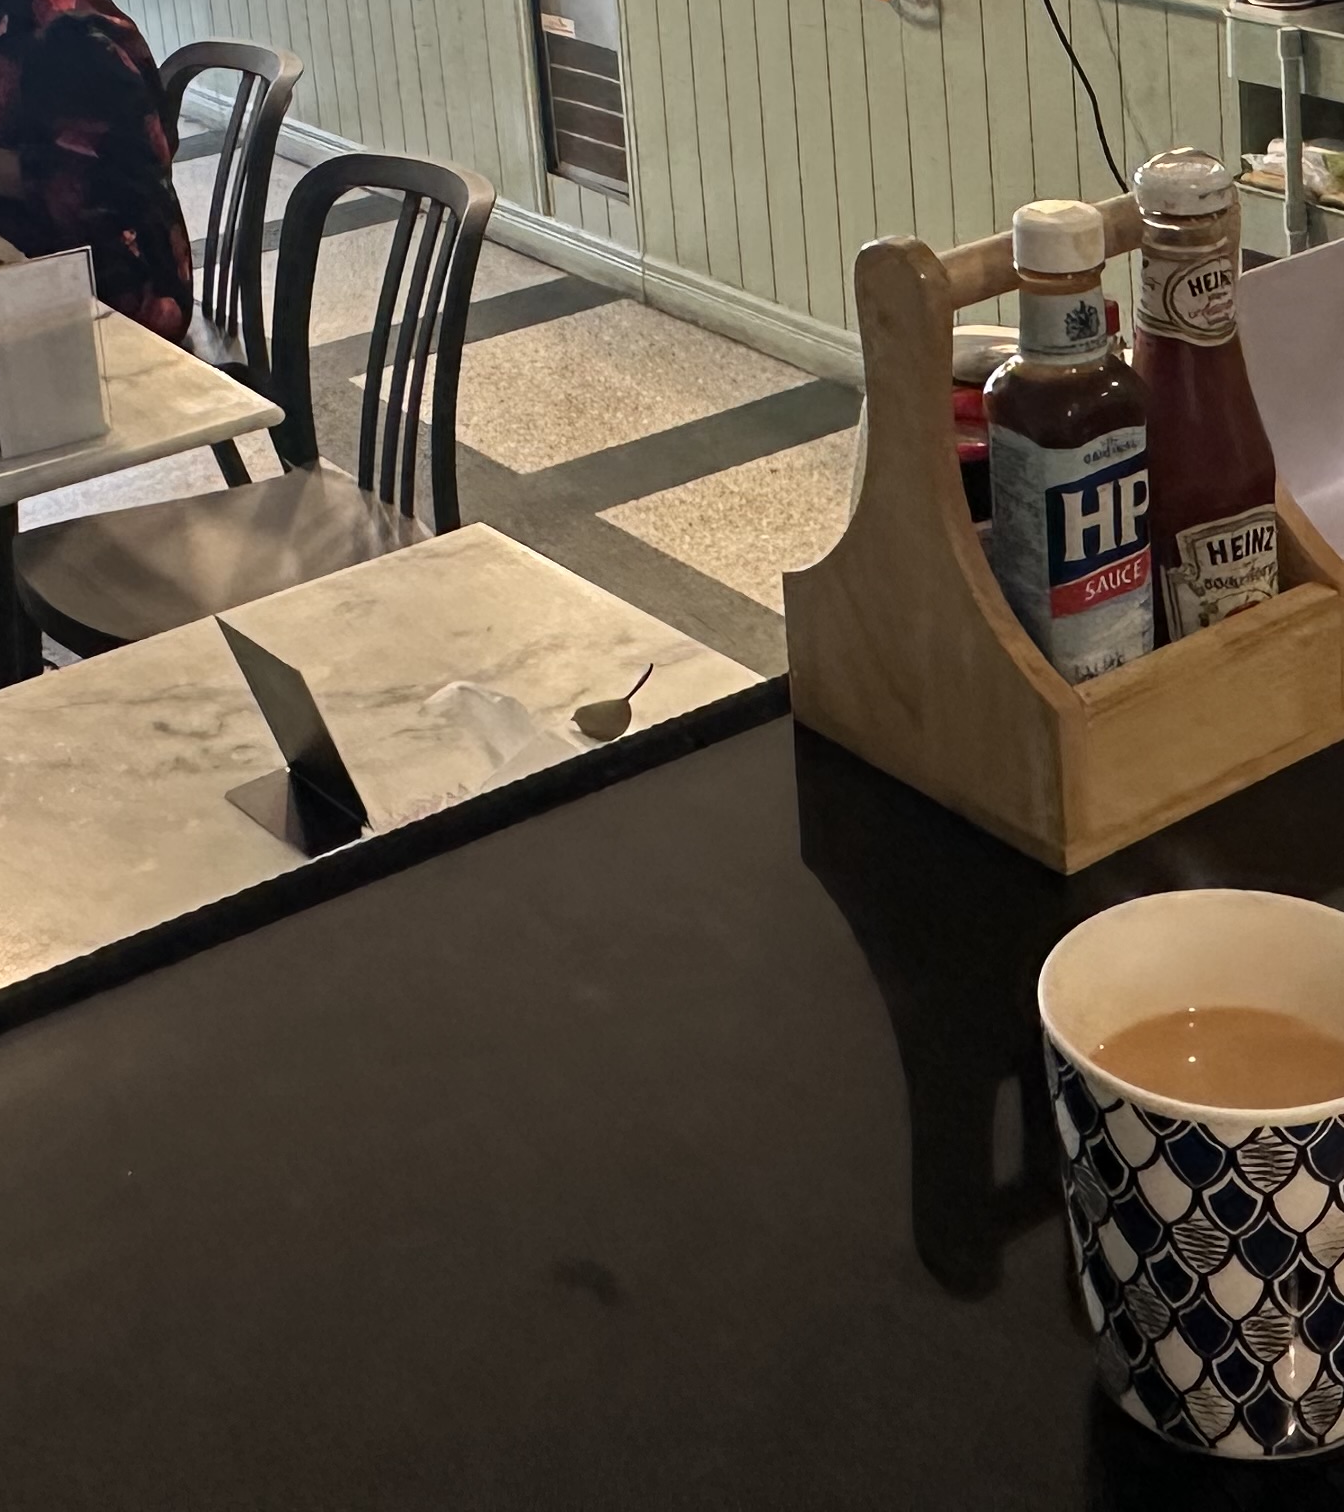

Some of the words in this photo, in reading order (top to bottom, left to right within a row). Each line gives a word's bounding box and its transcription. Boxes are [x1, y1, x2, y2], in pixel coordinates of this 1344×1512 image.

[1186, 270, 1232, 298] HEIN
[1061, 468, 1150, 564] HP
[1206, 525, 1275, 567] HEINZ
[1084, 558, 1143, 602] SAUCE
